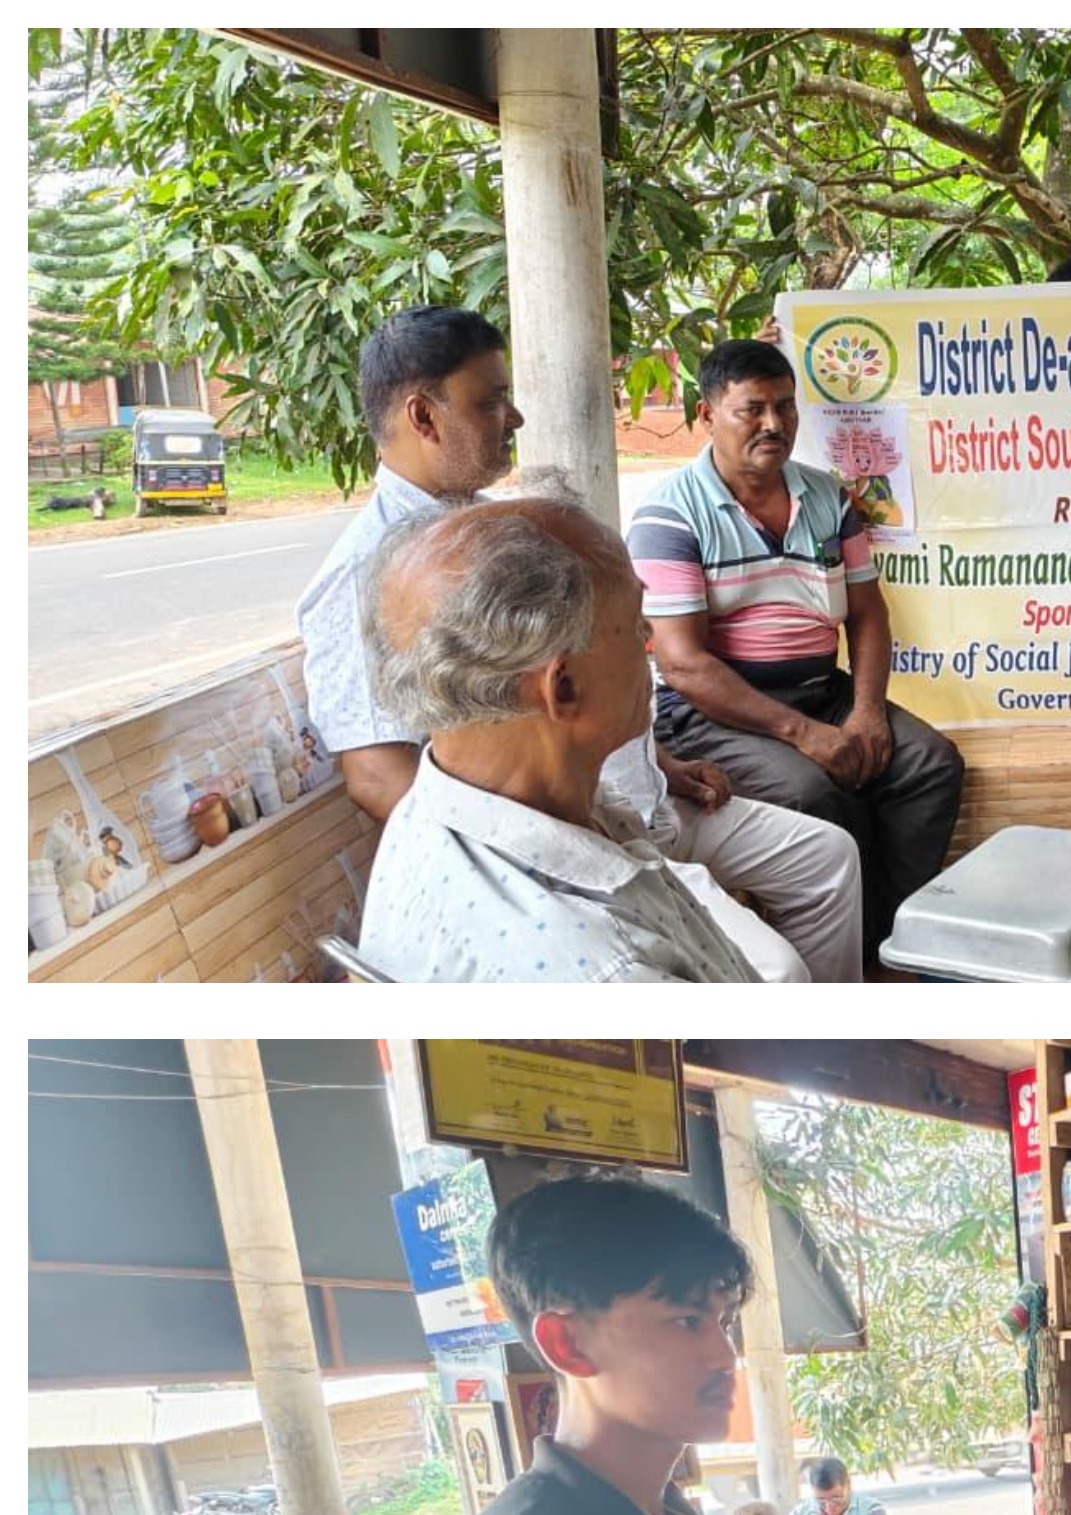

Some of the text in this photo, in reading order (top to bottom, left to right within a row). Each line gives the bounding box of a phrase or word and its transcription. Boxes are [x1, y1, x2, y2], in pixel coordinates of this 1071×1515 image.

[917, 319, 1016, 397] District
[928, 415, 1020, 474] District
[891, 641, 944, 679] istry
[952, 642, 981, 680] of
[985, 642, 1059, 674] Social
